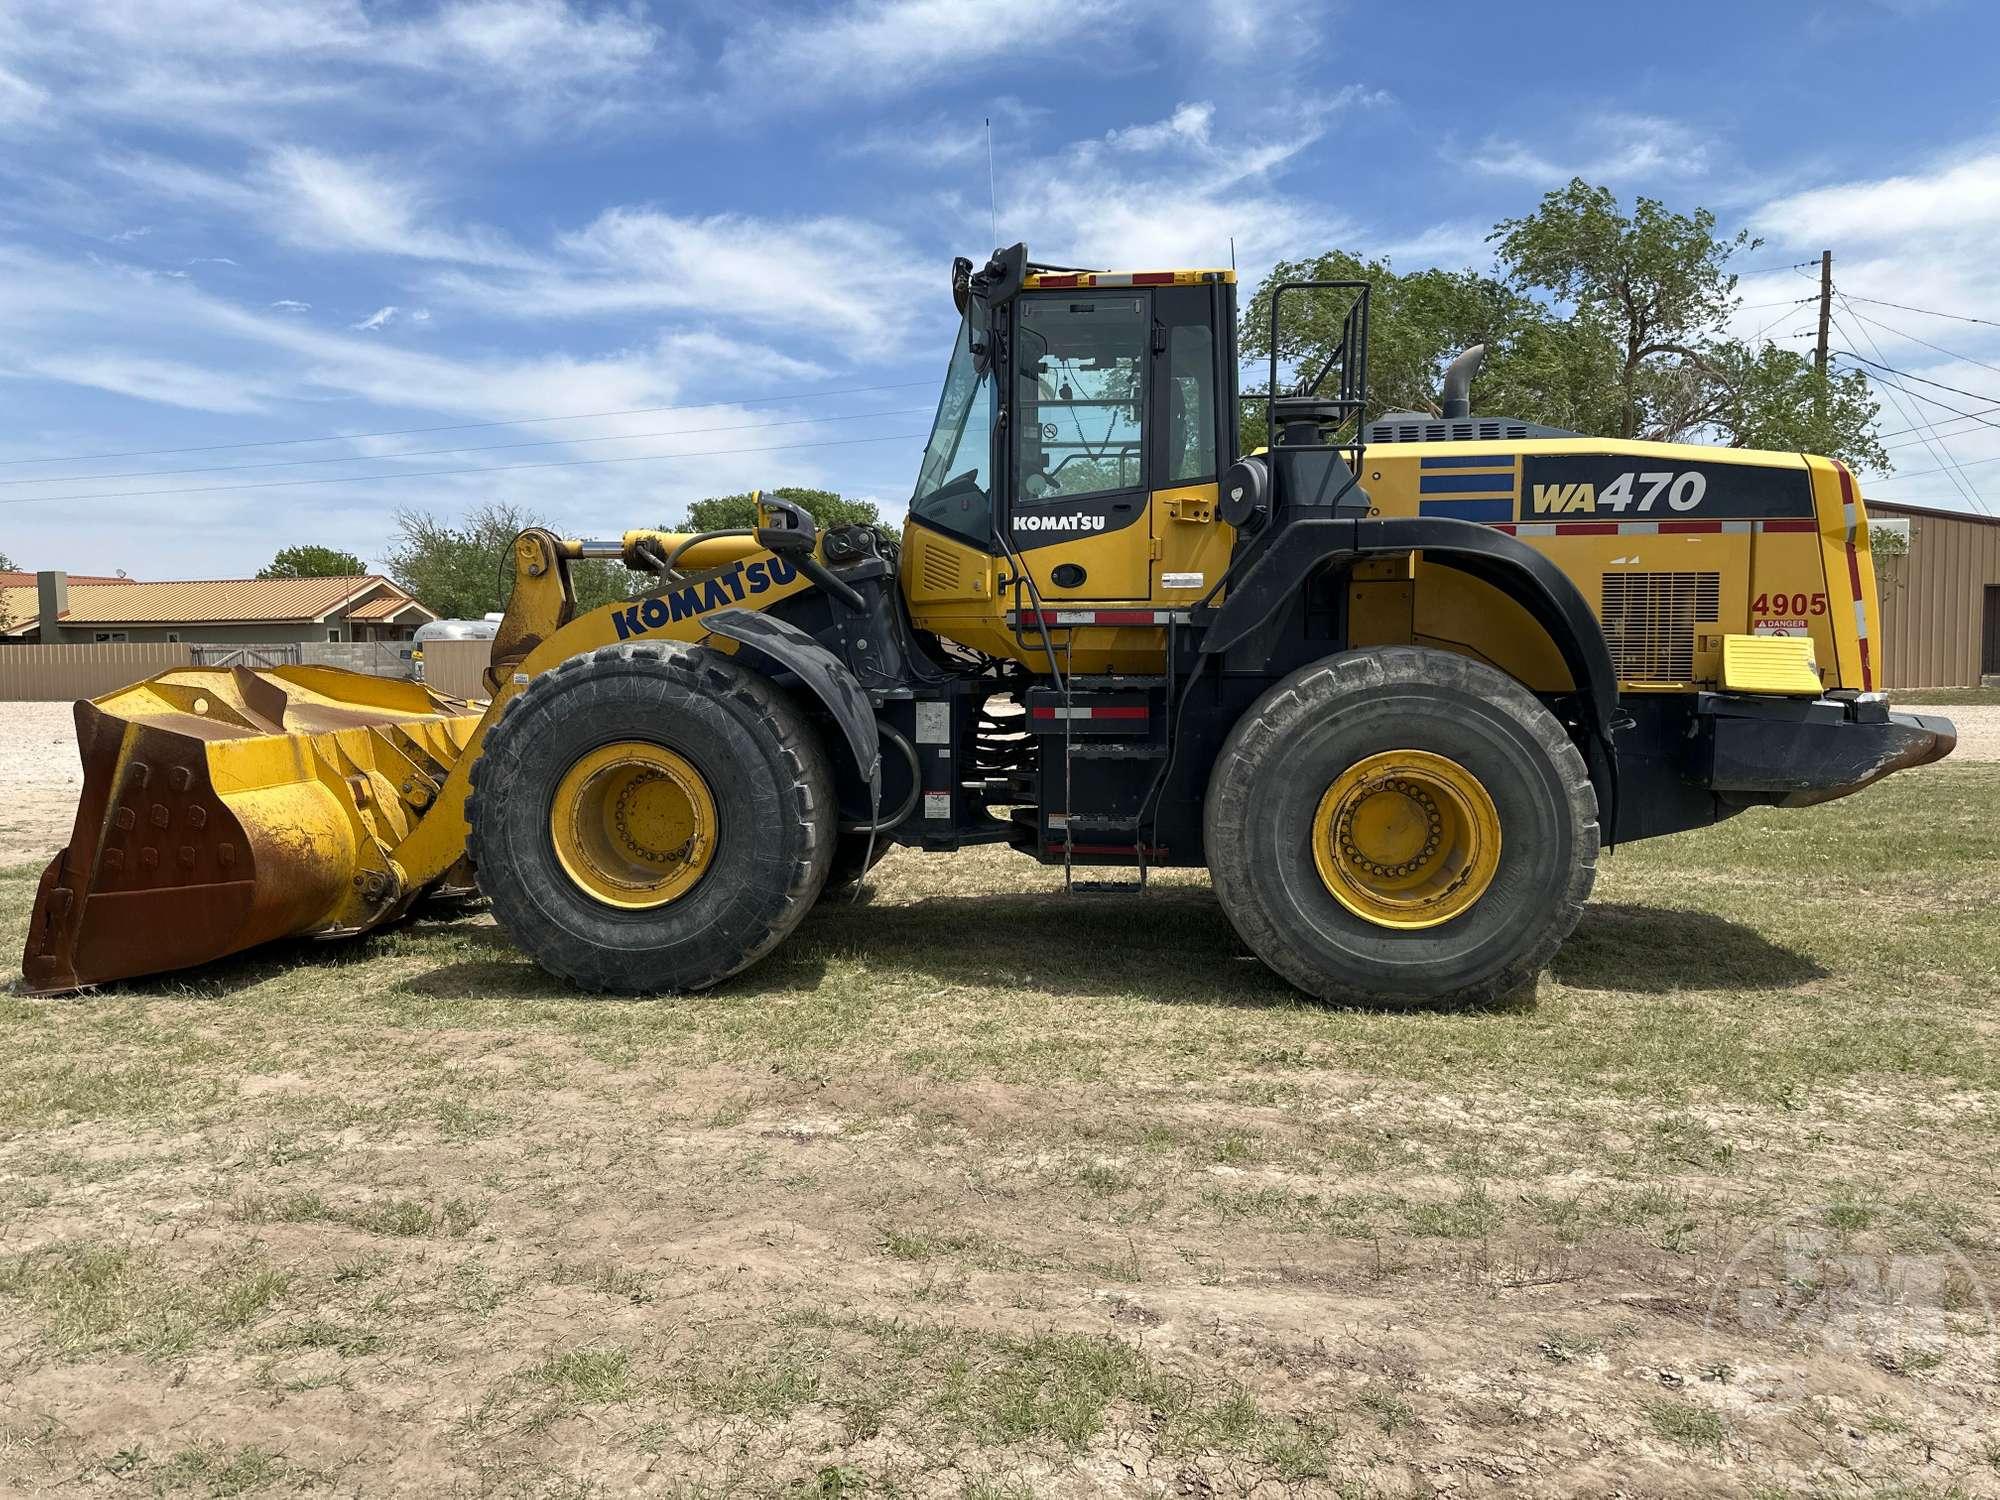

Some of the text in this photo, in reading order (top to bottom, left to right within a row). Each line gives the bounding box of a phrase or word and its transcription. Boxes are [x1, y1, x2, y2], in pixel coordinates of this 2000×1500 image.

[1533, 471, 1707, 514] WA470
[1013, 512, 1105, 531] KOMATSU
[611, 556, 798, 641] KOMATSU
[1752, 593, 1826, 616] 4905
